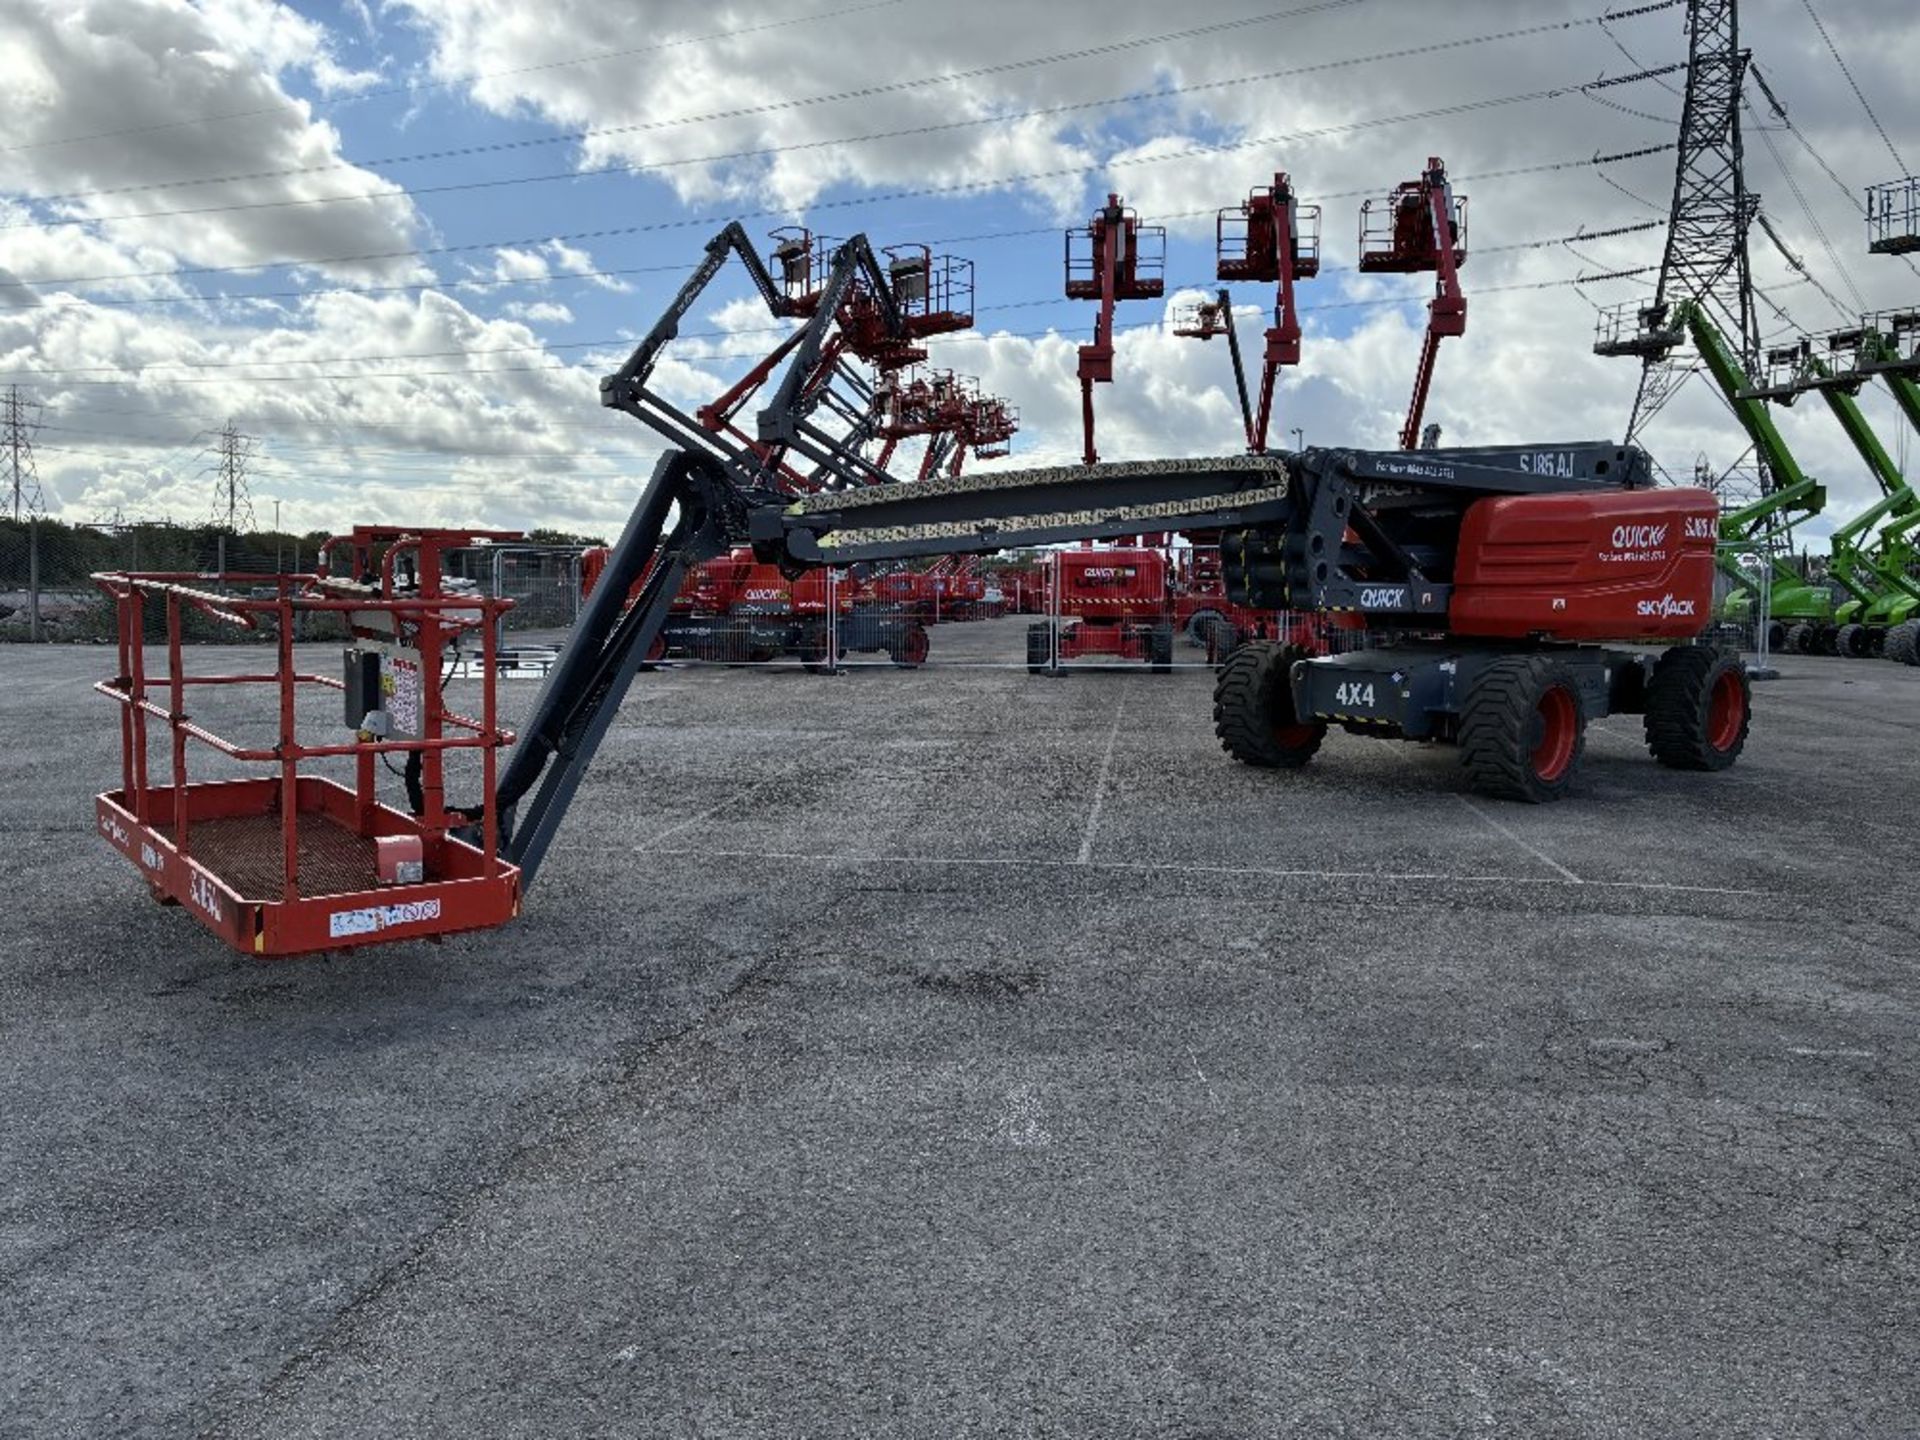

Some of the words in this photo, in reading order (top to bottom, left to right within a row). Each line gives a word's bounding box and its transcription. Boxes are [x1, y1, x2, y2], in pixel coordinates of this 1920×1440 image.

[1556, 452, 1575, 478] AJ
[1612, 524, 1661, 548] QUICK
[1360, 588, 1404, 608] QUICK
[1637, 593, 1694, 619] SKYJACK
[1335, 682, 1376, 707] 4X4
